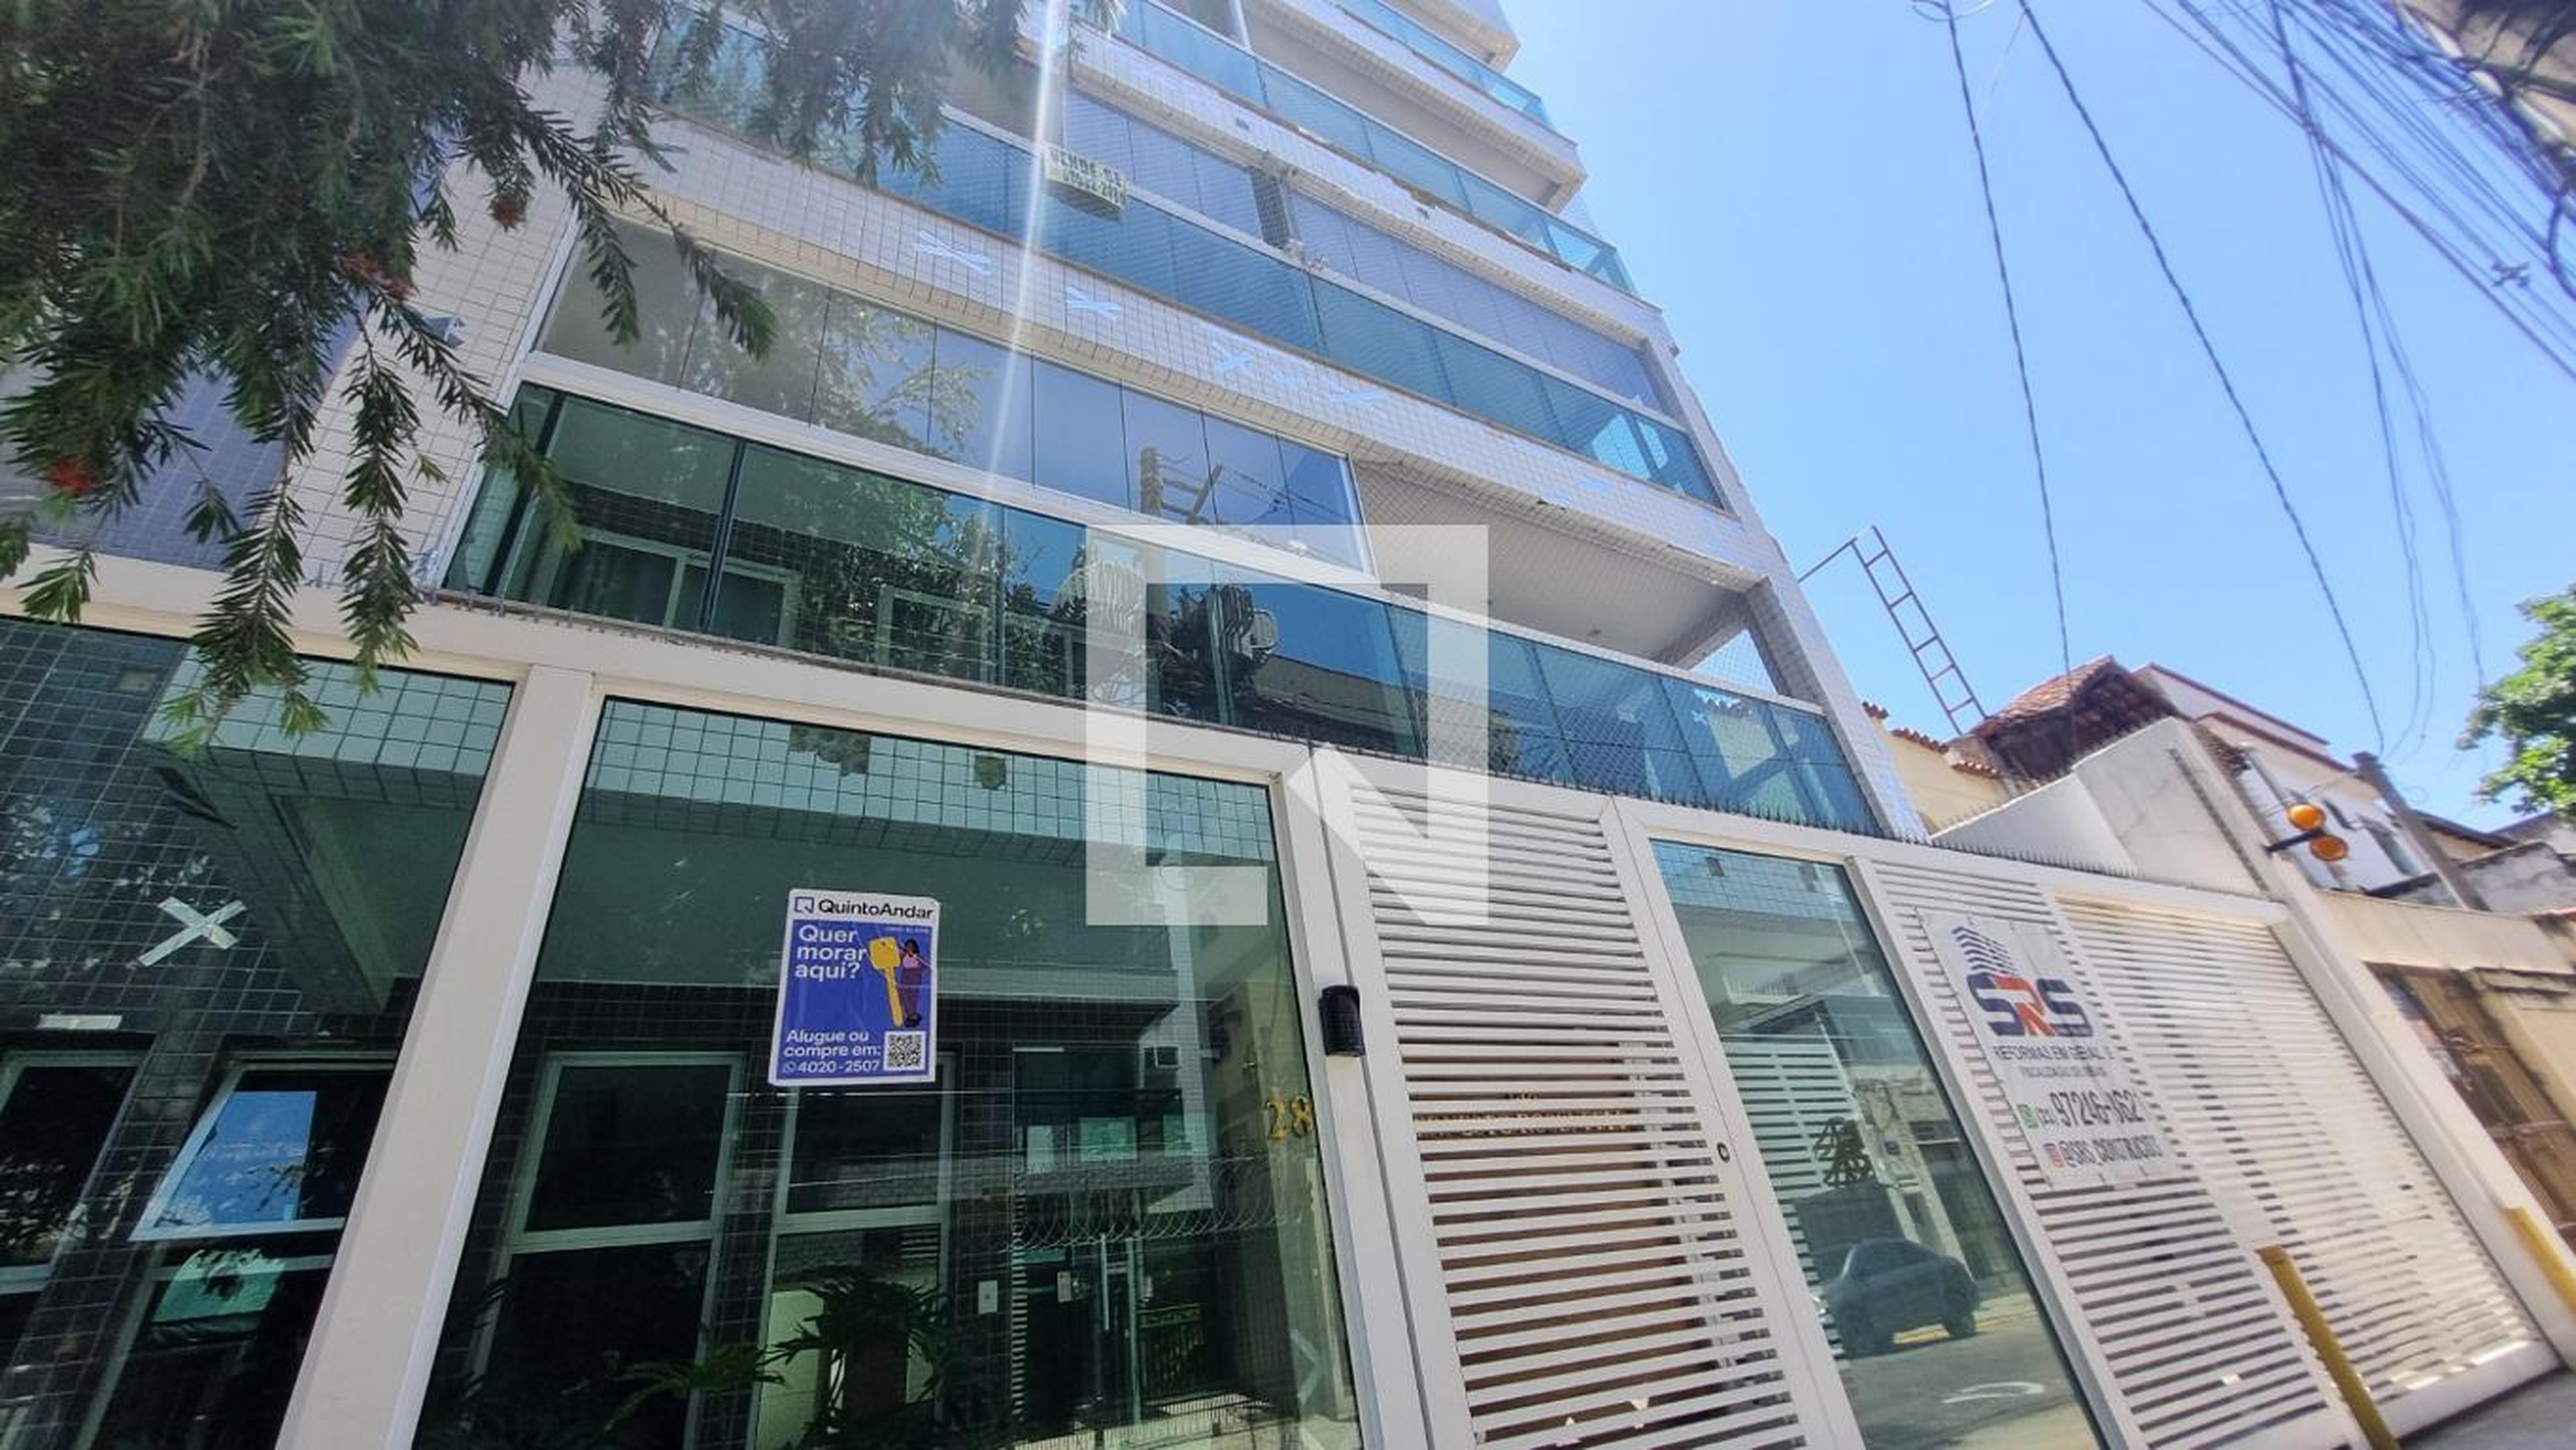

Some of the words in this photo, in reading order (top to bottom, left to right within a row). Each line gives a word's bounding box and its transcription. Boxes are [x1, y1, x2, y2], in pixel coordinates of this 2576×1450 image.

[818, 898, 934, 919] QuintoAndar
[799, 924, 858, 942] Quer
[796, 945, 867, 961] morar
[795, 962, 861, 983] aqui?
[1967, 972, 2093, 1038] SRS
[786, 1029, 845, 1045] Alugue
[849, 1031, 869, 1042] ou
[784, 1045, 848, 1059] compre
[851, 1044, 881, 1056] em:
[797, 1060, 880, 1074] 4020-2507
[1267, 1095, 1314, 1141] 28
